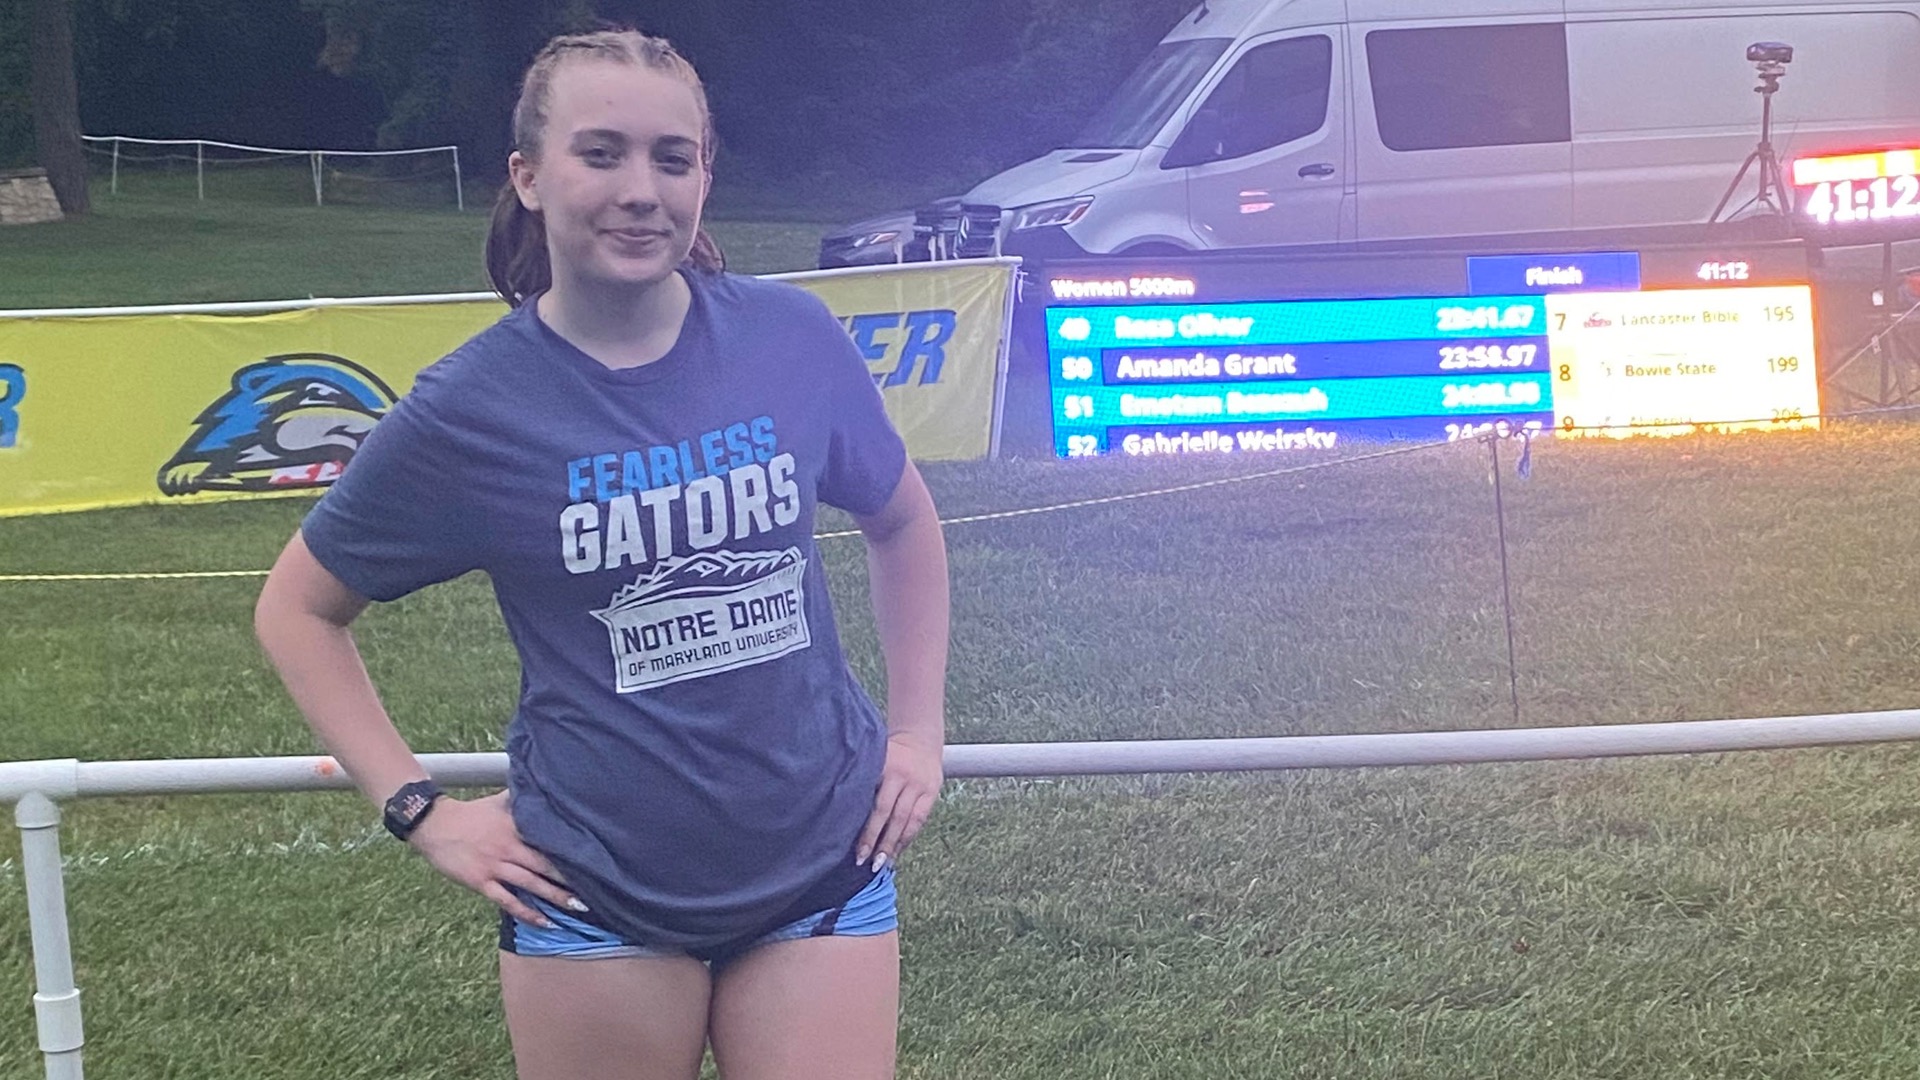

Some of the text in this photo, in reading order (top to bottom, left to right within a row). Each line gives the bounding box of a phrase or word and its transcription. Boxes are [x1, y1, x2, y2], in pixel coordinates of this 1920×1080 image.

[1806, 175, 1920, 224] 41:12
[1526, 266, 1583, 286] Finish
[1697, 262, 1749, 280] 41:12
[1051, 278, 1195, 297] Women 5000m
[1555, 305, 1794, 331] 7 Lancaster Bible 195
[838, 309, 956, 388] ER
[1117, 353, 1220, 378] Amanda
[1224, 353, 1297, 375] Grant
[1559, 356, 1798, 382] 8 Bowie State 199
[1064, 394, 1094, 419] 51
[567, 415, 777, 502] FEARLESS
[559, 453, 800, 574] GATORS
[620, 589, 797, 654] NOTRE DAME
[629, 622, 798, 677] OF MARYLAND UNIVERSITY
